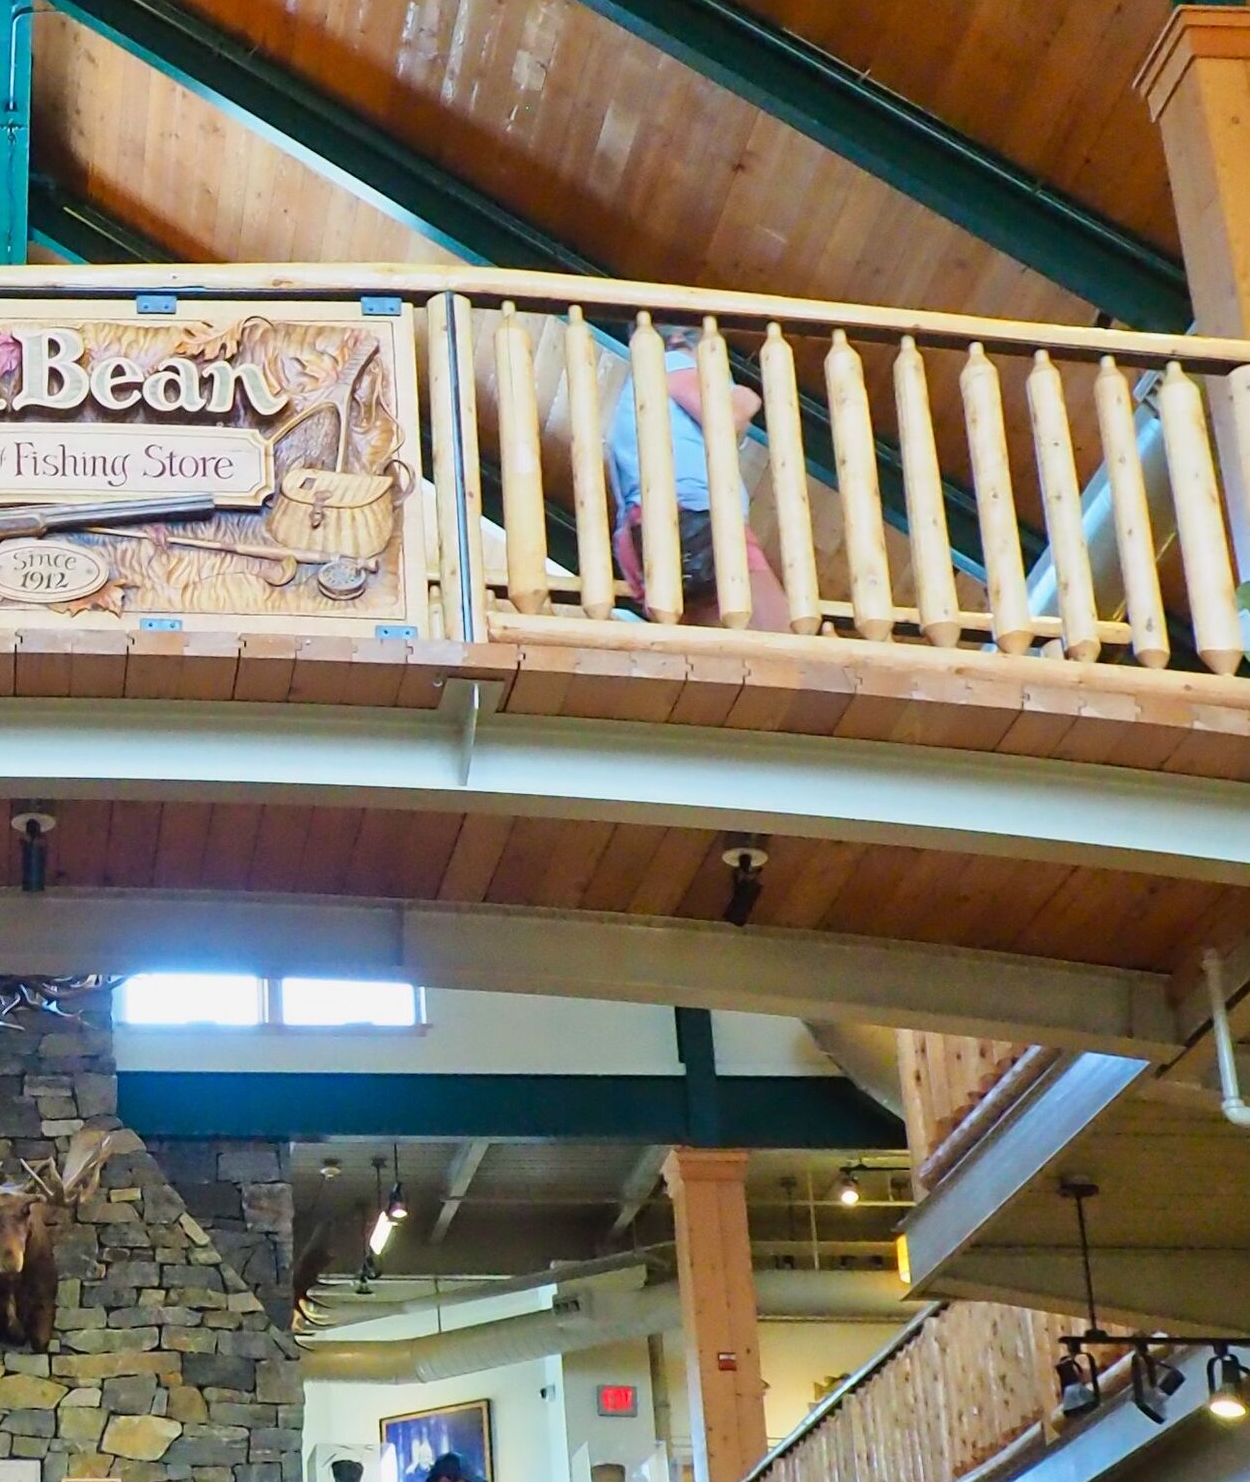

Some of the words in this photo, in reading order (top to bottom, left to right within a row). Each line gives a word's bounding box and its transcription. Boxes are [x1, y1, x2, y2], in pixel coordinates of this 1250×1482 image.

[13, 440, 131, 487] Fishing
[143, 443, 235, 480] Store
[13, 551, 77, 571] Since
[20, 570, 70, 590] 1912
